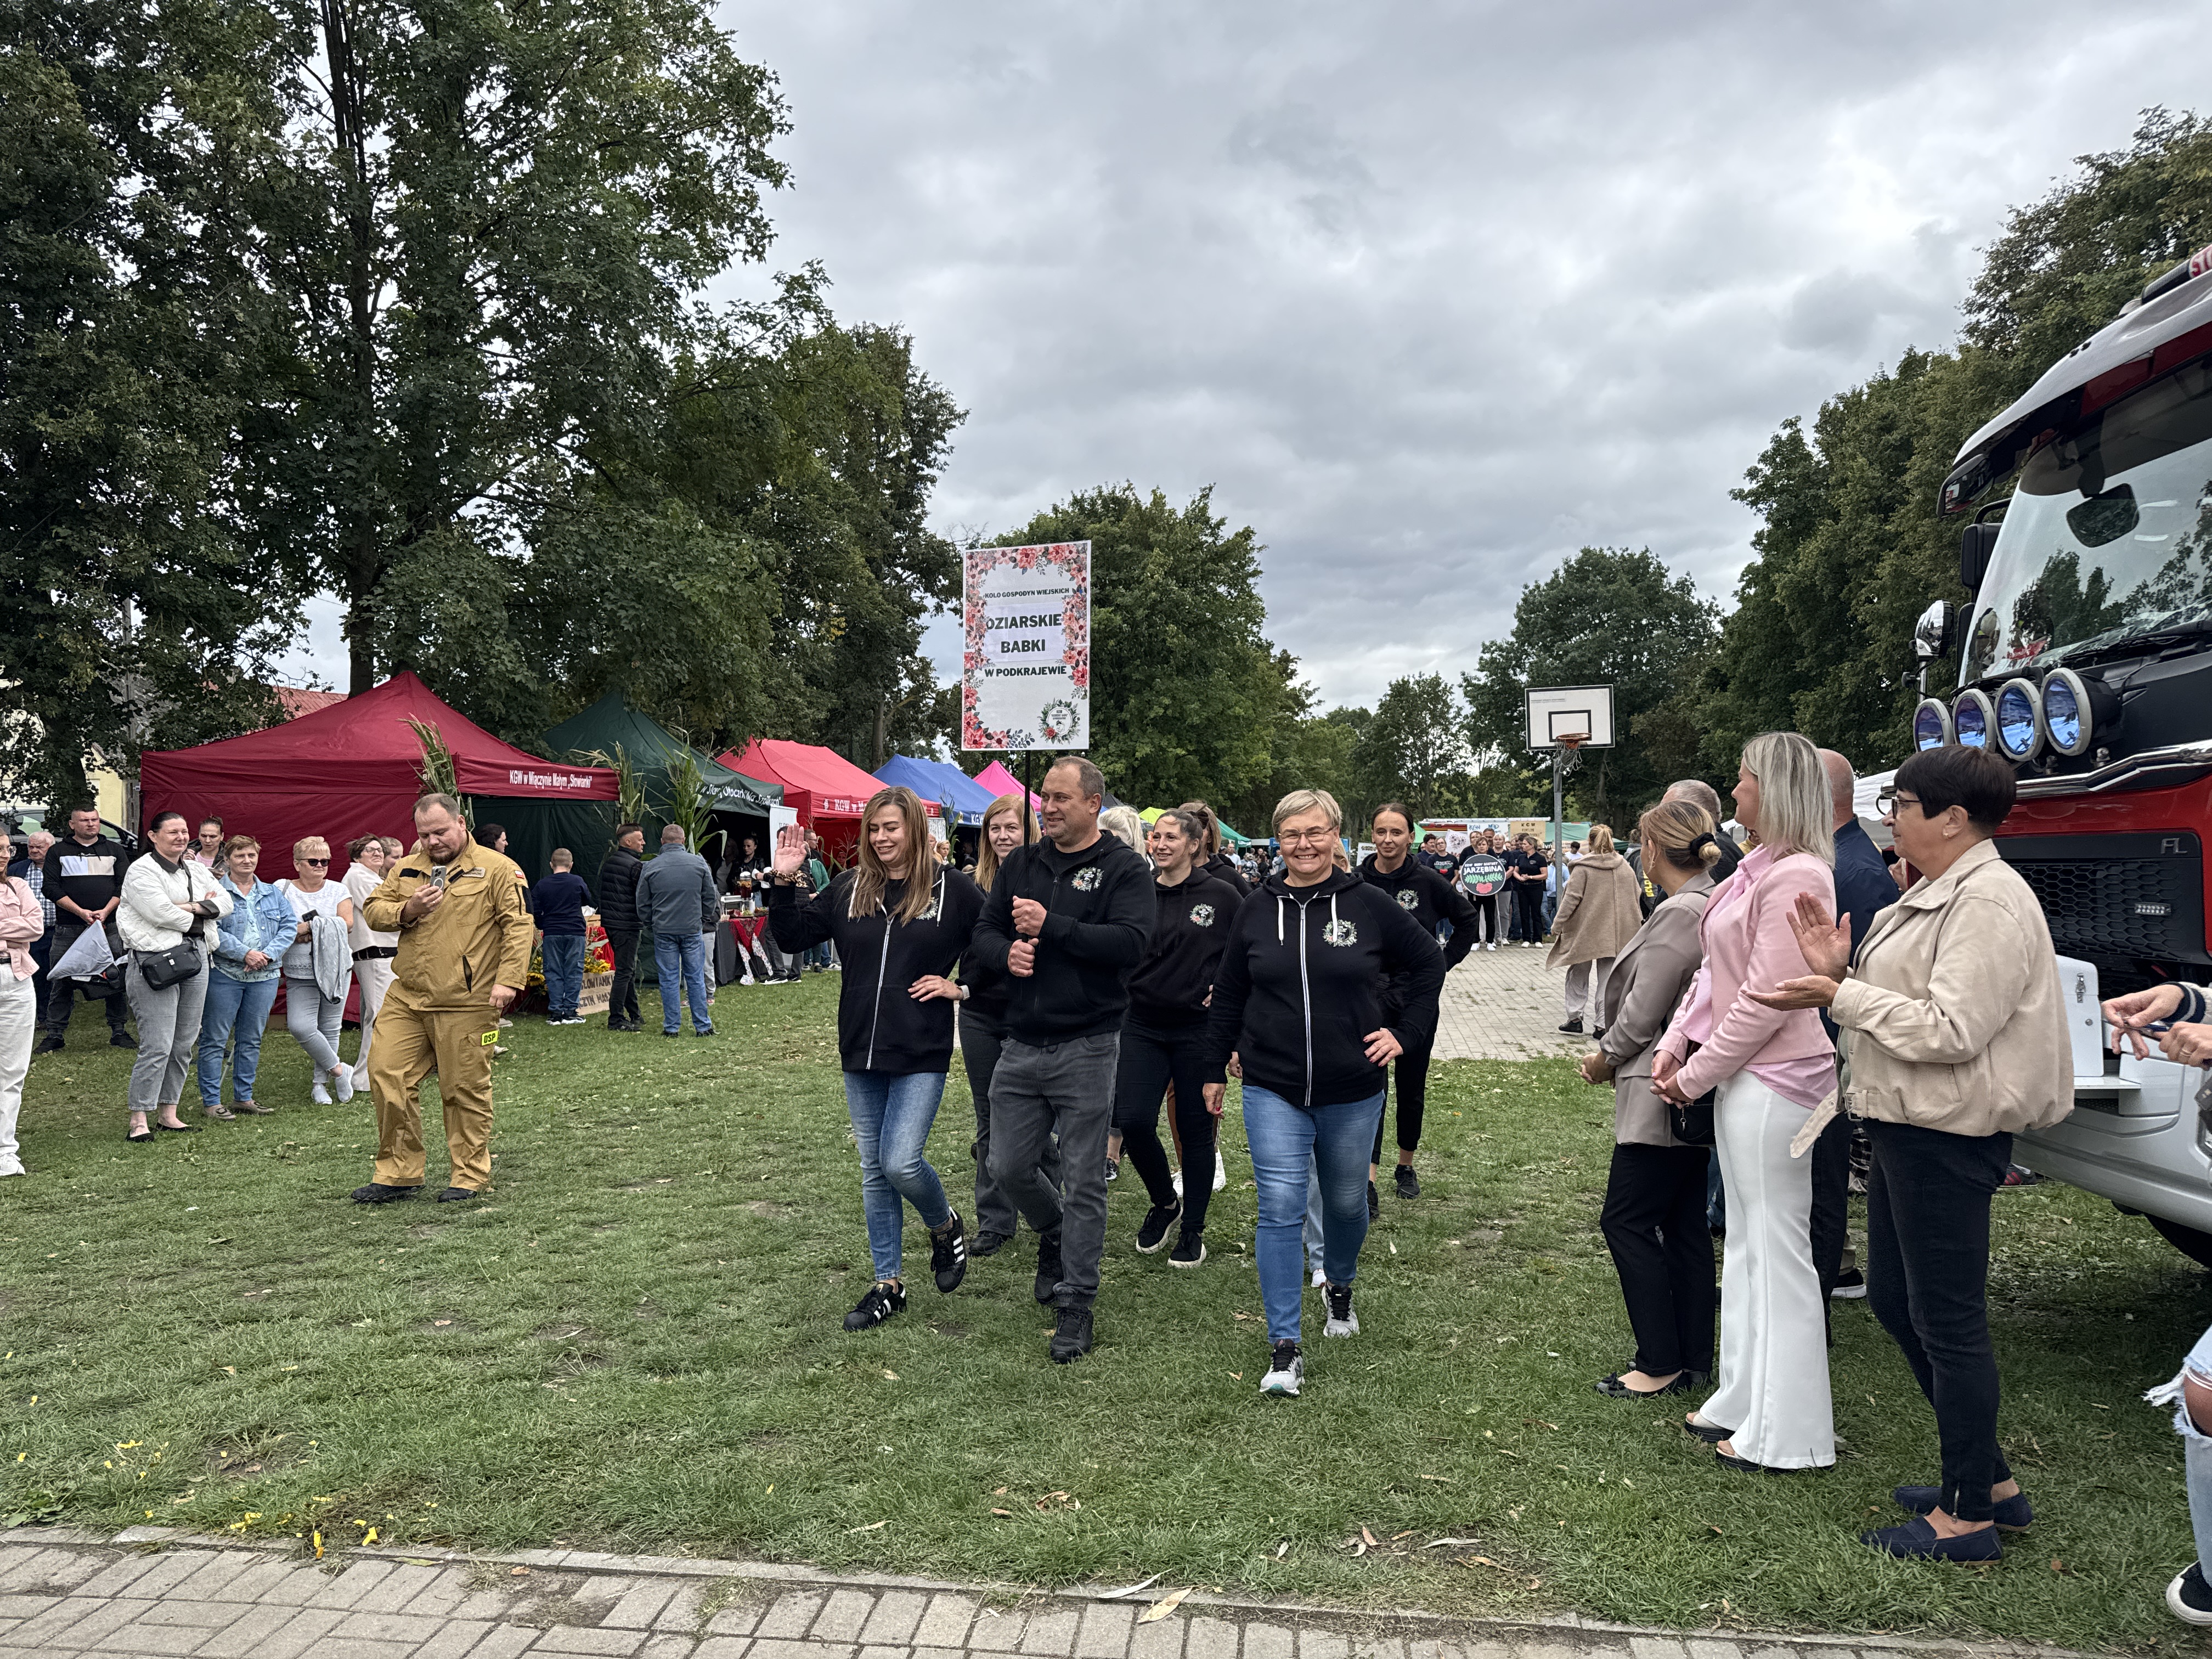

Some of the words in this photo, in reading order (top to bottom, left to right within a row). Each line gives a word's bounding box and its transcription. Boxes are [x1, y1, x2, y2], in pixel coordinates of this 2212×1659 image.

[1001, 639, 1046, 653] BABKI
[985, 668, 995, 678] W
[996, 665, 1067, 677] PODKRAJEWIE
[510, 770, 523, 785] KGW
[523, 775, 528, 785] w
[528, 771, 552, 789] Miączynie
[552, 772, 567, 790] Małym
[834, 799, 850, 812] KGW
[2160, 838, 2188, 854] FL
[1463, 865, 1503, 875] JARZĘBINA
[483, 1032, 496, 1043] OSP
